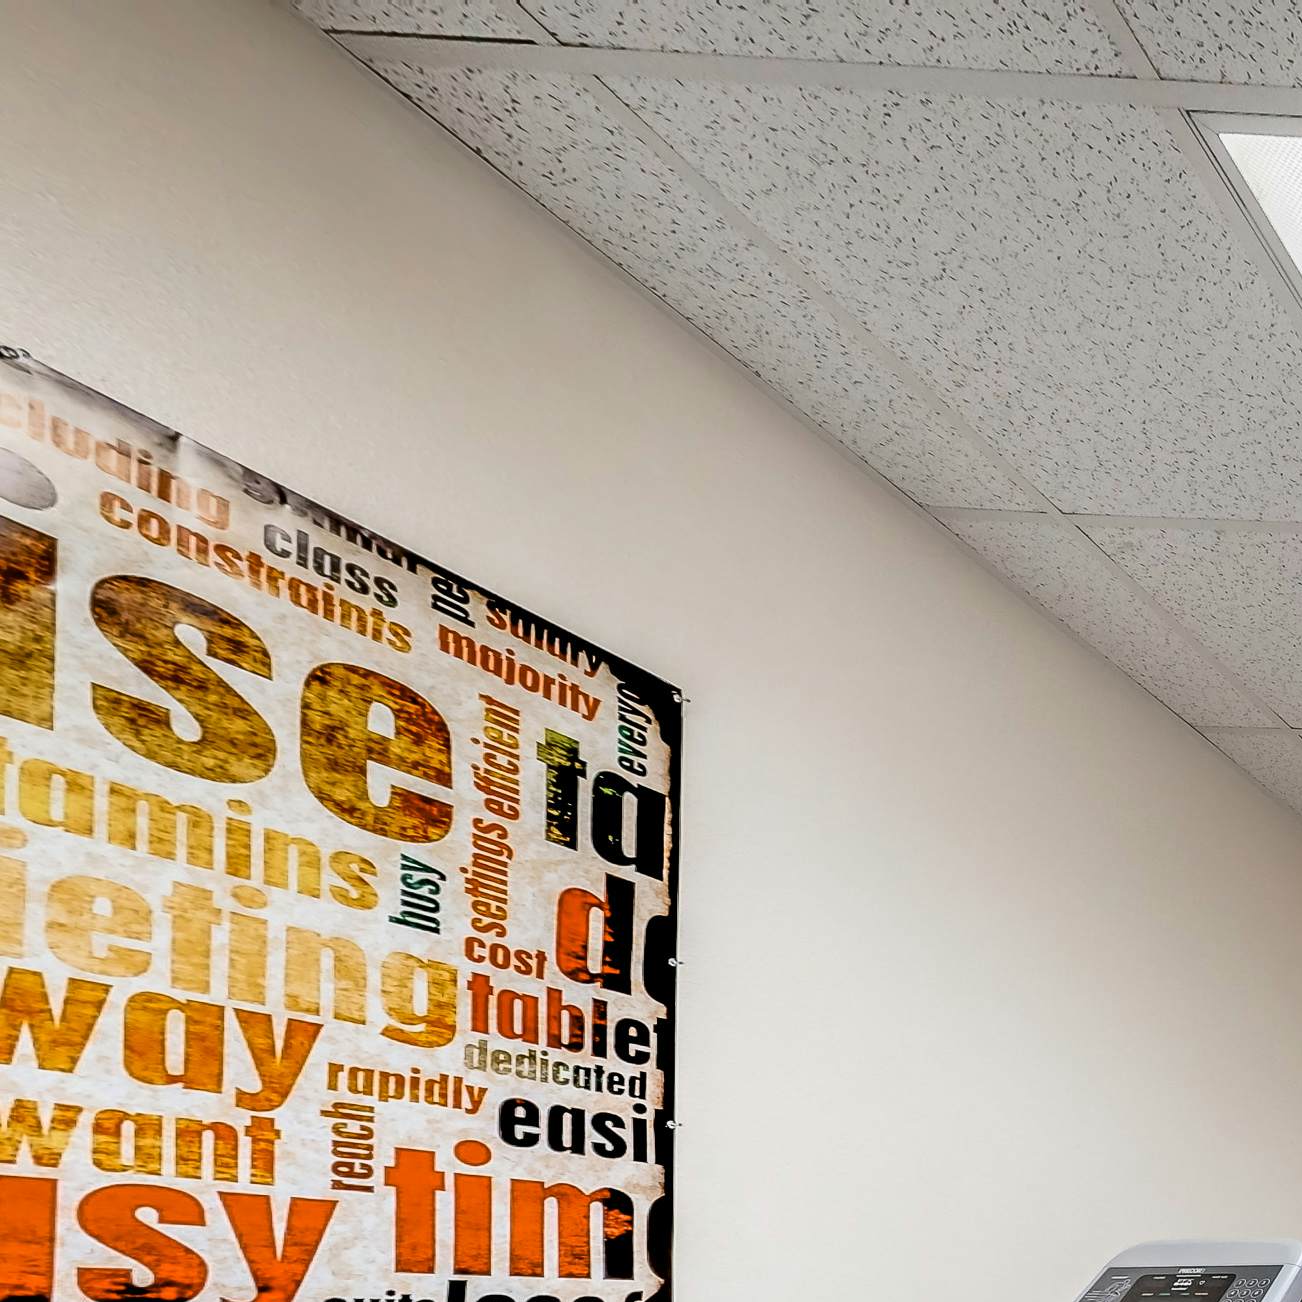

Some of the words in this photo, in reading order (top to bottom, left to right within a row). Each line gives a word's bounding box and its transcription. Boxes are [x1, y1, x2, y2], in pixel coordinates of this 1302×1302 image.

[100, 490, 412, 653] constraints
[263, 524, 399, 609] class
[438, 624, 602, 722] majority
[470, 693, 521, 821] efficient
[388, 853, 447, 935] busy
[459, 818, 516, 938] settings
[463, 936, 549, 980] cost
[0, 966, 325, 1112] way
[463, 1040, 648, 1100] dedicated
[326, 1062, 489, 1115] rapidly
[0, 1098, 282, 1186] want
[319, 1100, 375, 1192] reach
